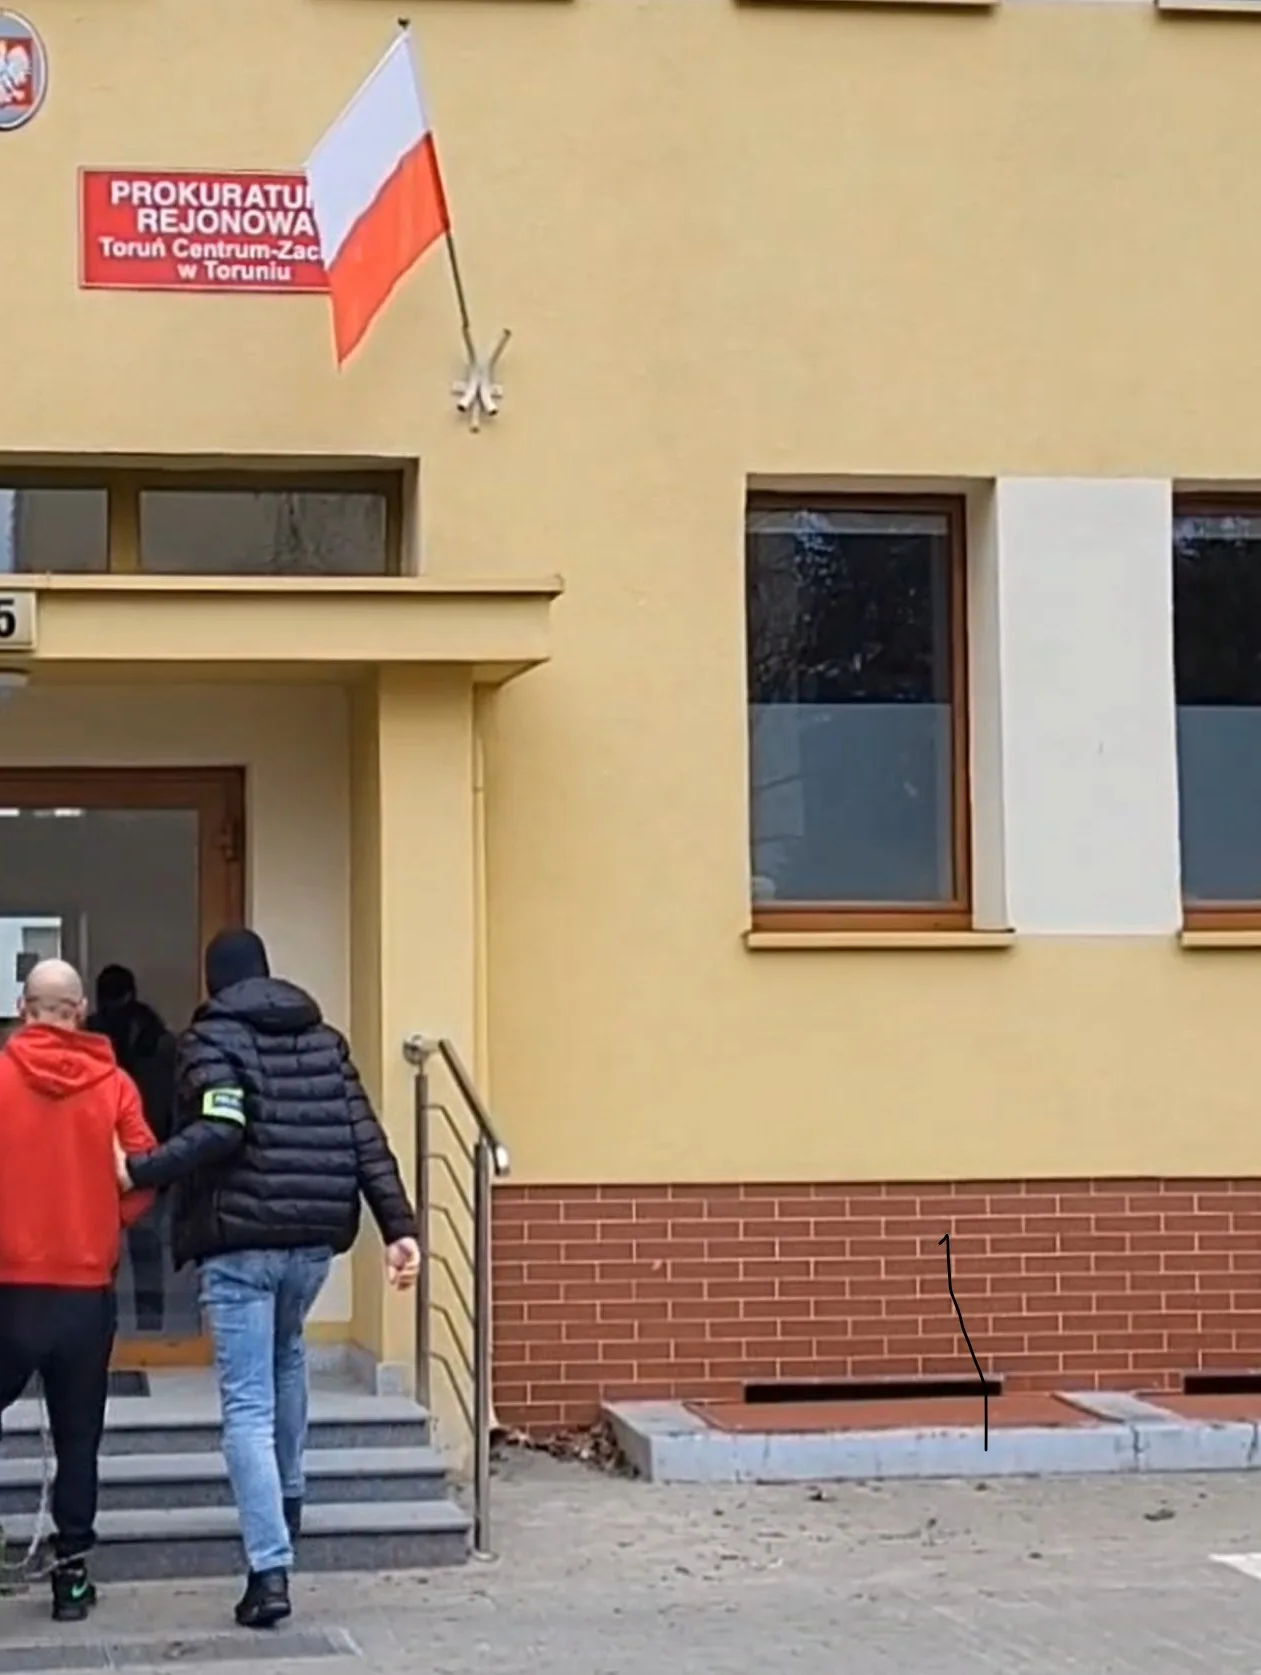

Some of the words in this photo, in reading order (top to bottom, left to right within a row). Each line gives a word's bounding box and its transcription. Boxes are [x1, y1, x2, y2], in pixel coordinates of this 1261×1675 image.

[110, 180, 311, 209] PROKURATU
[137, 208, 315, 236] REJONOWA
[98, 236, 166, 258] Toruń
[172, 238, 320, 261] Centrum-Zac
[177, 263, 197, 279] w
[203, 260, 291, 281] Toruniu
